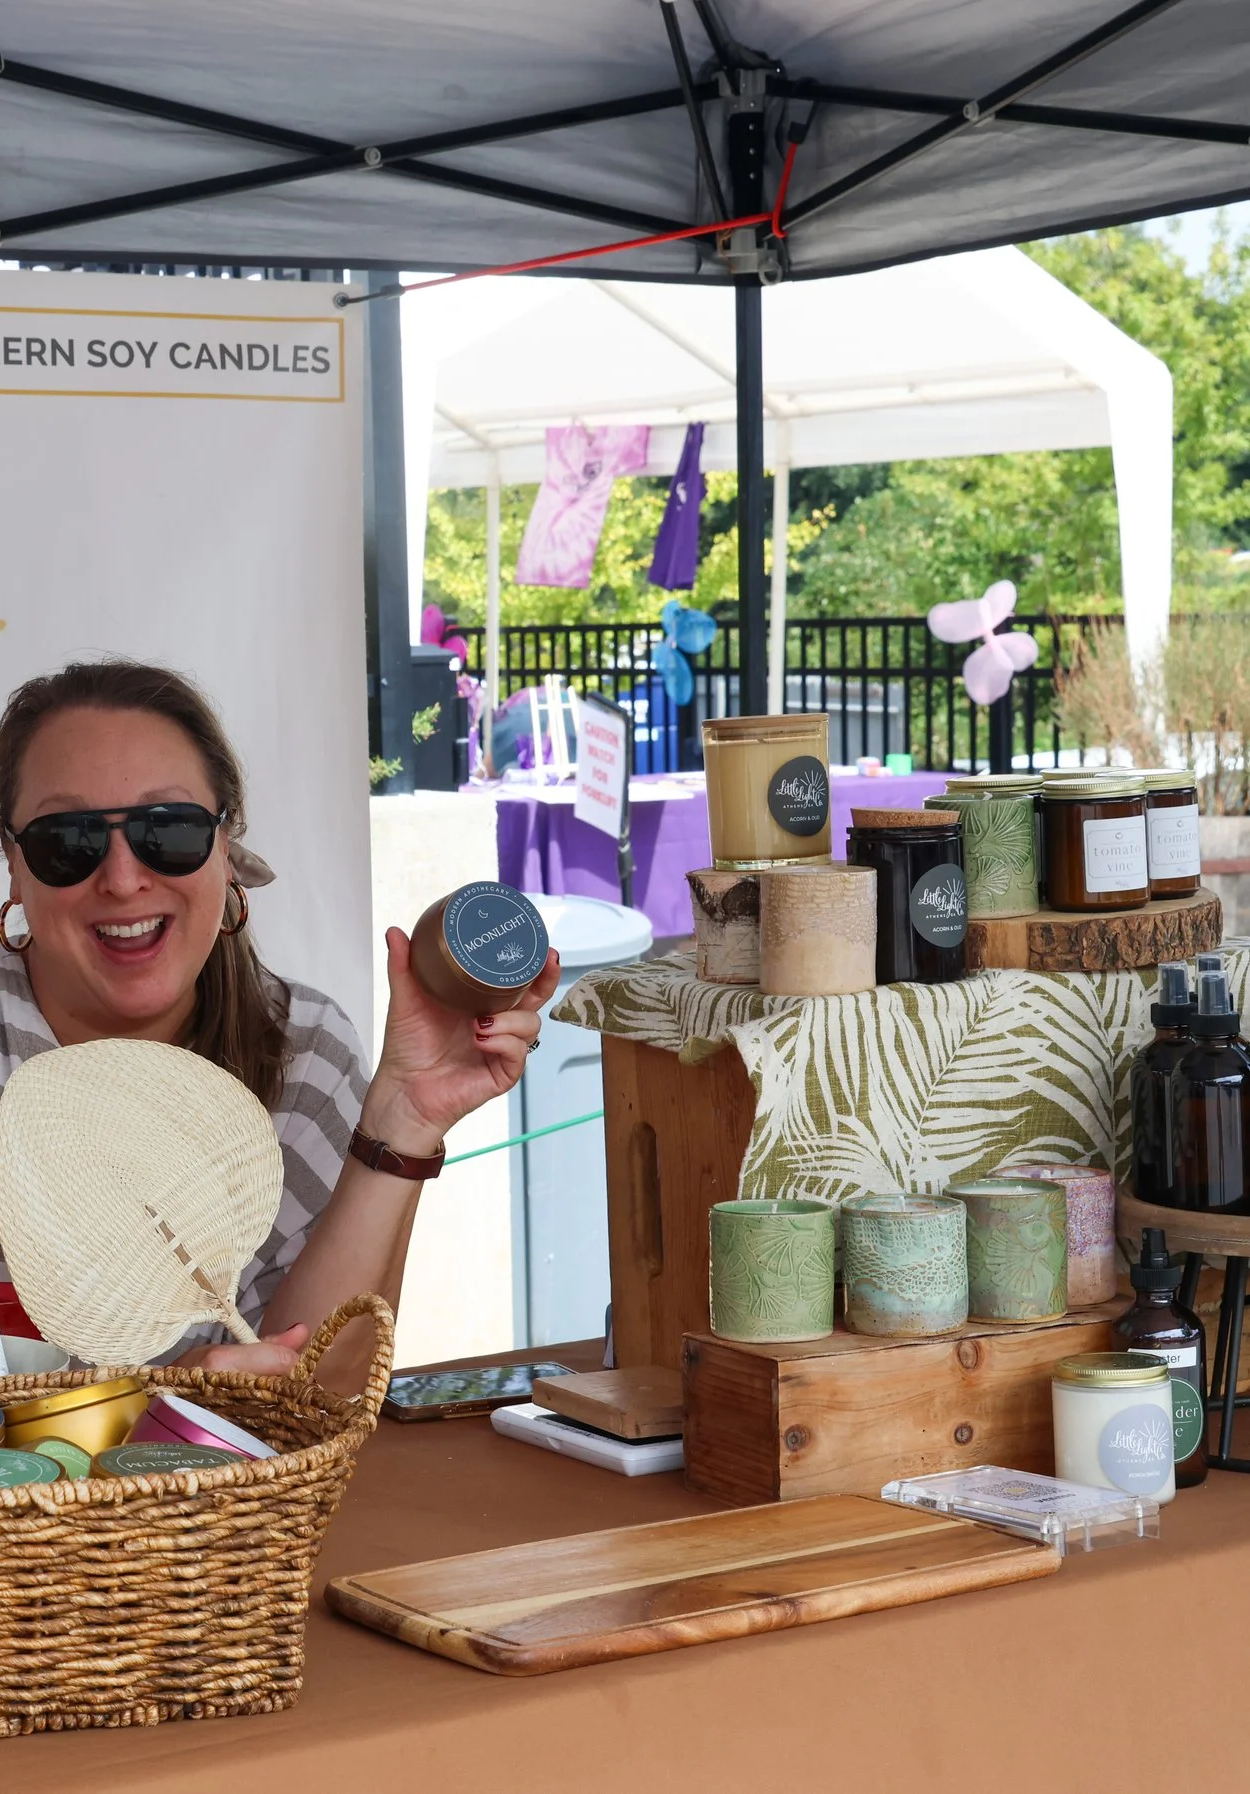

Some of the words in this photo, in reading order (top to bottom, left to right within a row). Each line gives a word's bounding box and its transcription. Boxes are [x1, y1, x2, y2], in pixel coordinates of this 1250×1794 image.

[86, 338, 160, 370] SOY
[168, 341, 331, 375] CANDLES
[775, 777, 800, 798] Little
[794, 783, 816, 809] Light
[1156, 832, 1198, 845] tomato
[1093, 844, 1142, 858] tomato
[1169, 848, 1192, 862] vine
[1106, 862, 1134, 873] vine
[463, 886, 510, 899] APOTHECARY
[918, 886, 942, 907] Little
[936, 892, 958, 919] Light
[464, 912, 527, 954] MOONLIGHT
[499, 971, 533, 984] ORGANIC
[531, 956, 543, 972] SOY
[1109, 1429, 1137, 1451] Little
[1131, 1436, 1157, 1464] Light
[126, 1457, 220, 1469] TABACUM
